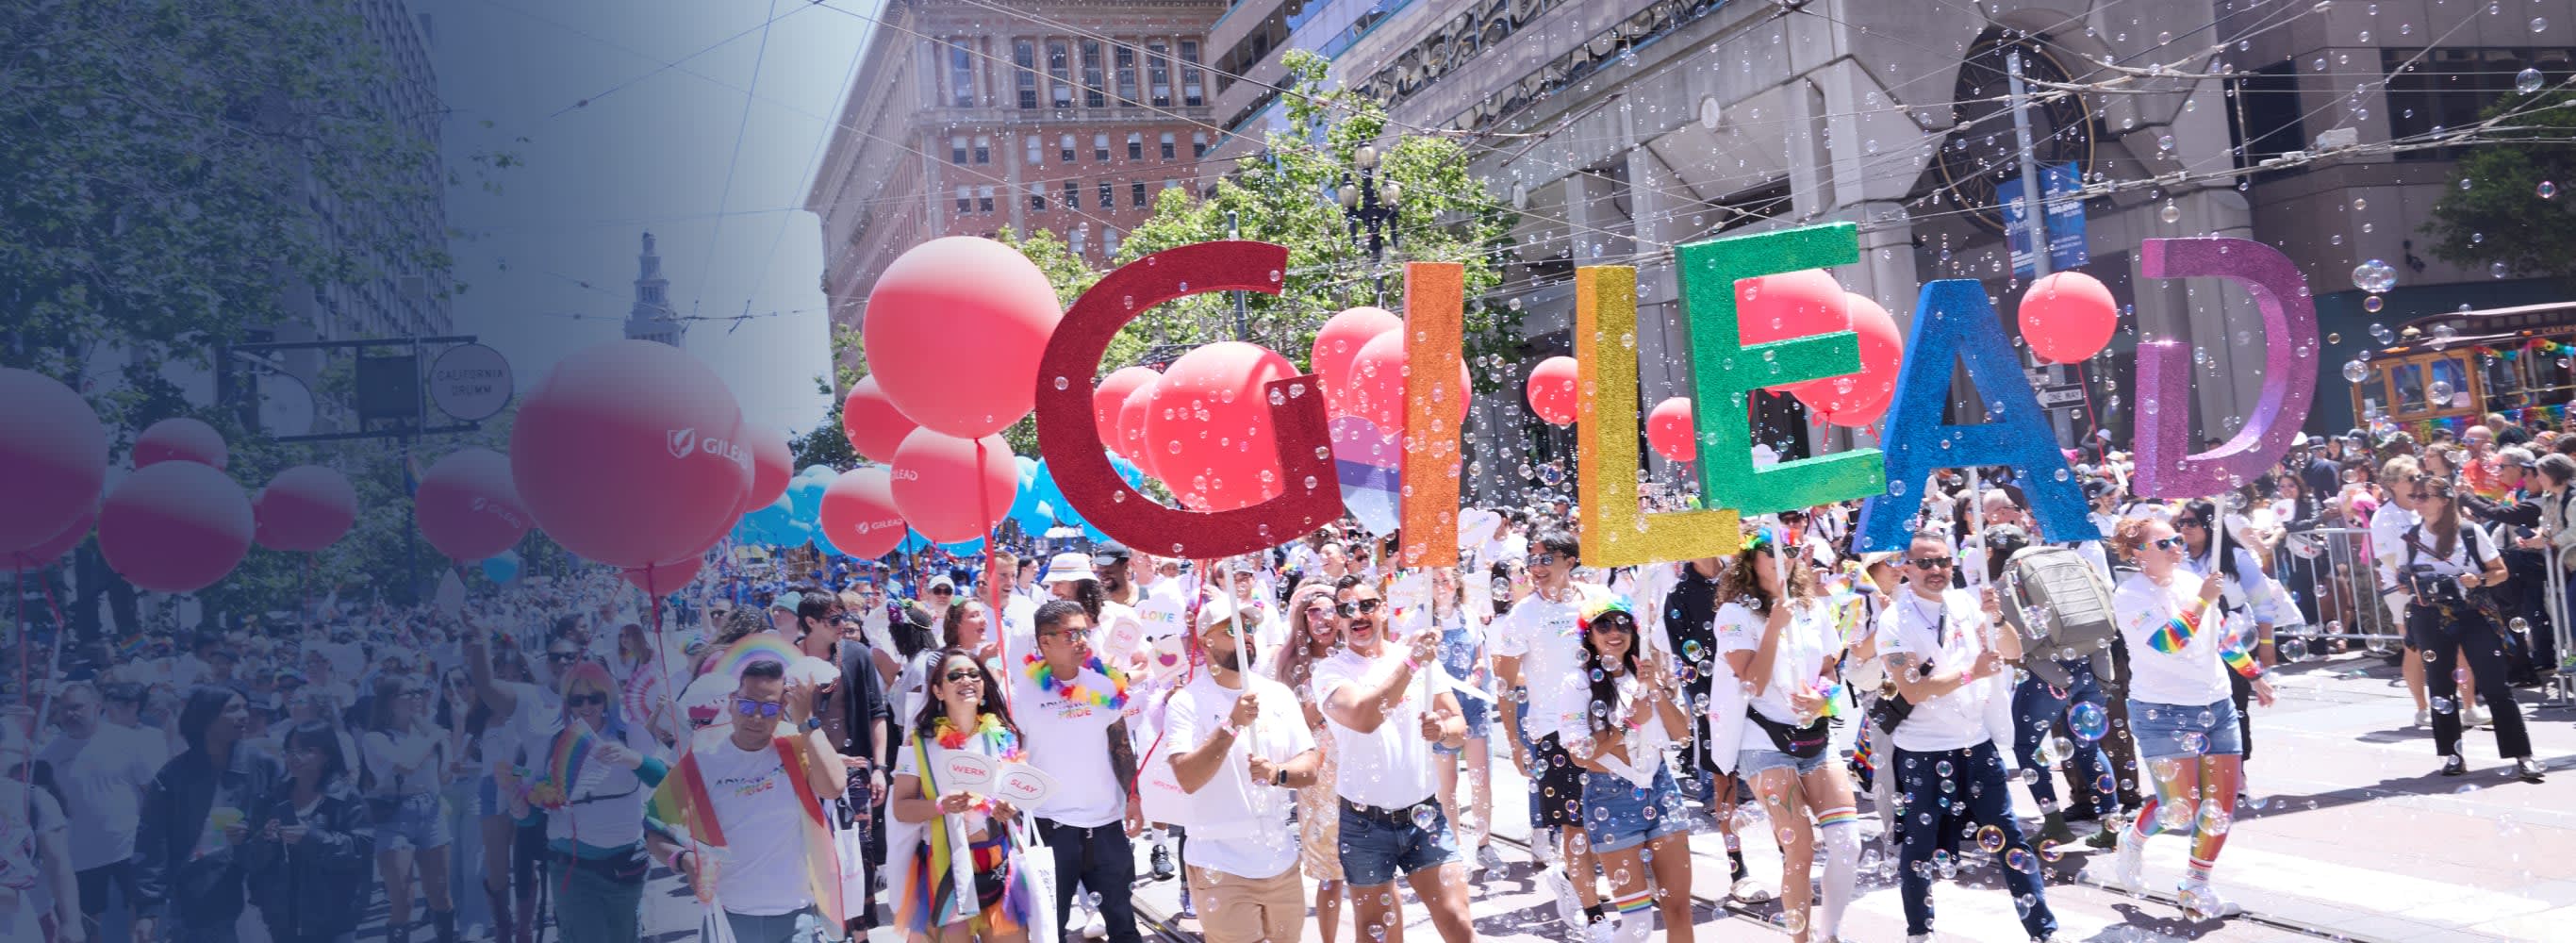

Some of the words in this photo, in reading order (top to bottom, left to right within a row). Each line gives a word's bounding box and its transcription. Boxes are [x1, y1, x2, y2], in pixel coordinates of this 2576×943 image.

[437, 369, 504, 382] CALIFORNIA
[452, 384, 491, 397] DRUMM
[1034, 221, 2320, 571] GILEAD
[2048, 392, 2063, 402] ONE
[2065, 390, 2080, 400] WAY
[1140, 609, 1176, 622] LOVE
[952, 763, 986, 777] WERK
[1010, 778, 1038, 793] SLAY
